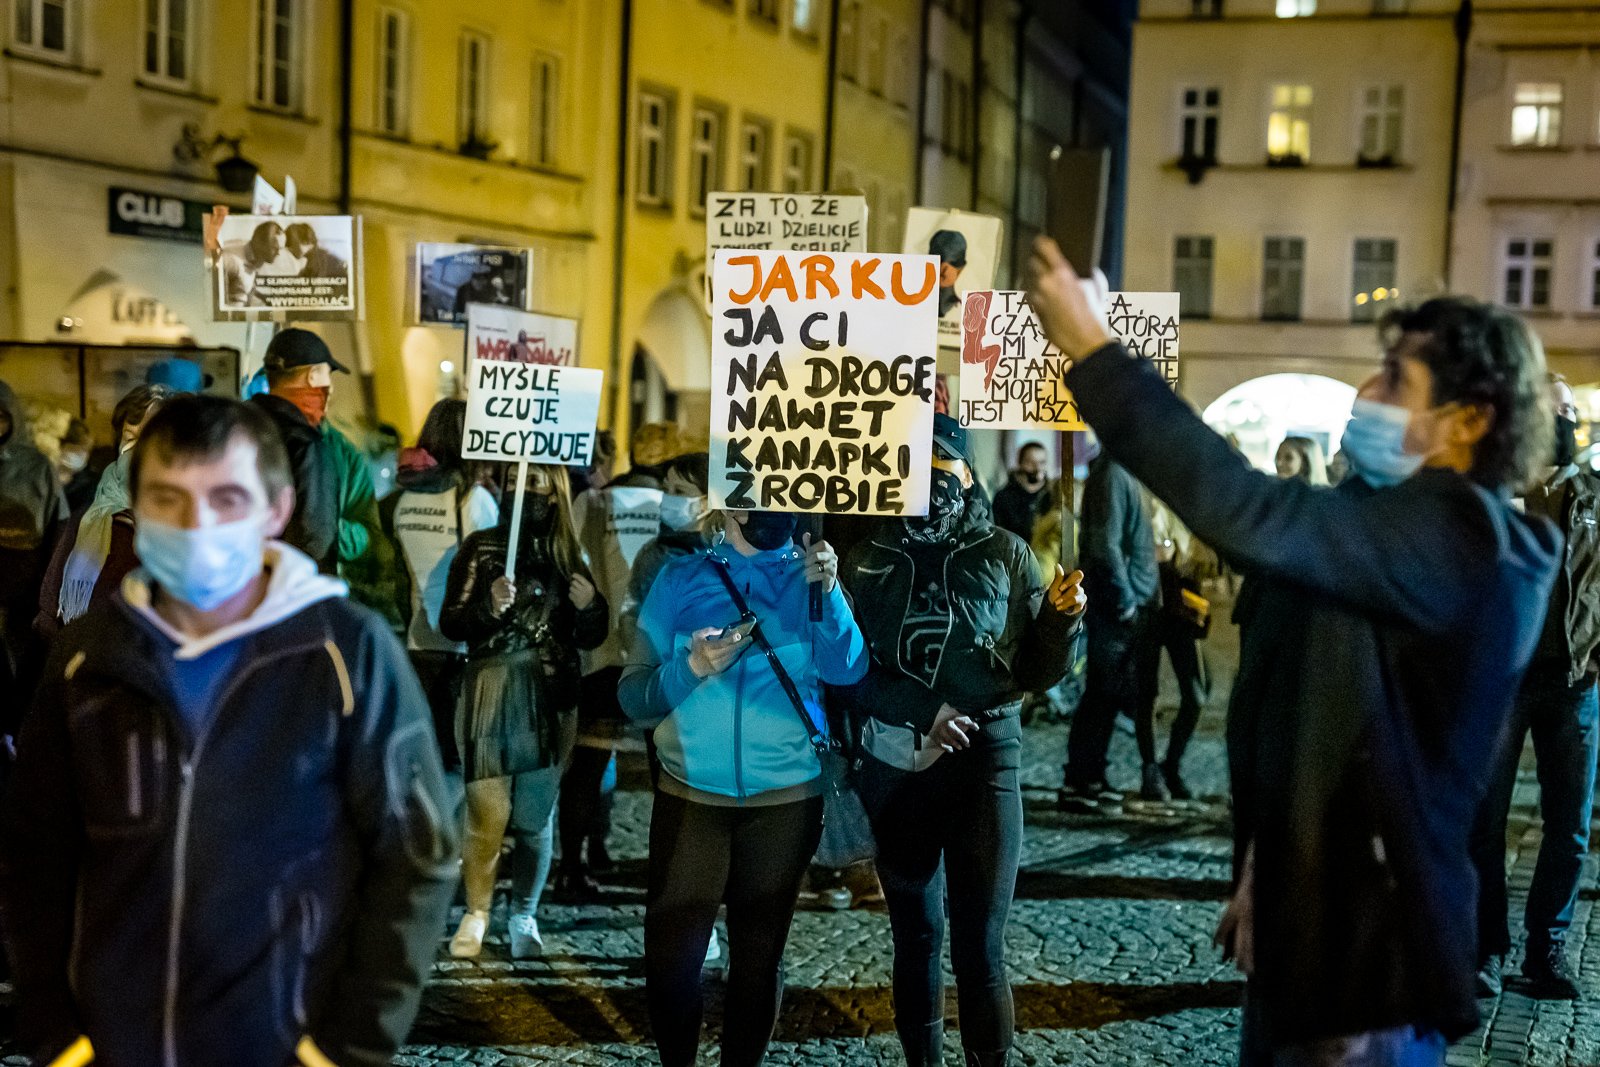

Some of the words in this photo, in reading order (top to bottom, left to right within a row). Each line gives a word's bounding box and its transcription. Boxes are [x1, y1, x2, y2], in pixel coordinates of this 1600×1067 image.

[117, 192, 185, 228] CLUB
[714, 197, 756, 218] ZA
[811, 195, 839, 216] ŻE
[720, 221, 772, 238] LUDZI
[782, 219, 860, 239] DZIELICIE
[727, 254, 937, 306] JARKU
[722, 304, 785, 348] JA
[800, 310, 849, 351] CI
[1107, 309, 1179, 342] KTÓRĄ
[1002, 336, 1026, 359] MI
[479, 362, 561, 395] MYŚLĘ
[726, 350, 789, 396] NA
[804, 354, 936, 404] DROGĘ
[991, 379, 1058, 406] MOJEJ
[485, 396, 560, 424] CZUJĘ
[727, 394, 896, 439] NAWET
[960, 400, 1010, 427] JEST
[466, 428, 591, 467] DECYDUJĘ
[725, 436, 911, 480] KANAPKI
[724, 472, 905, 515] ZROBIĘ
